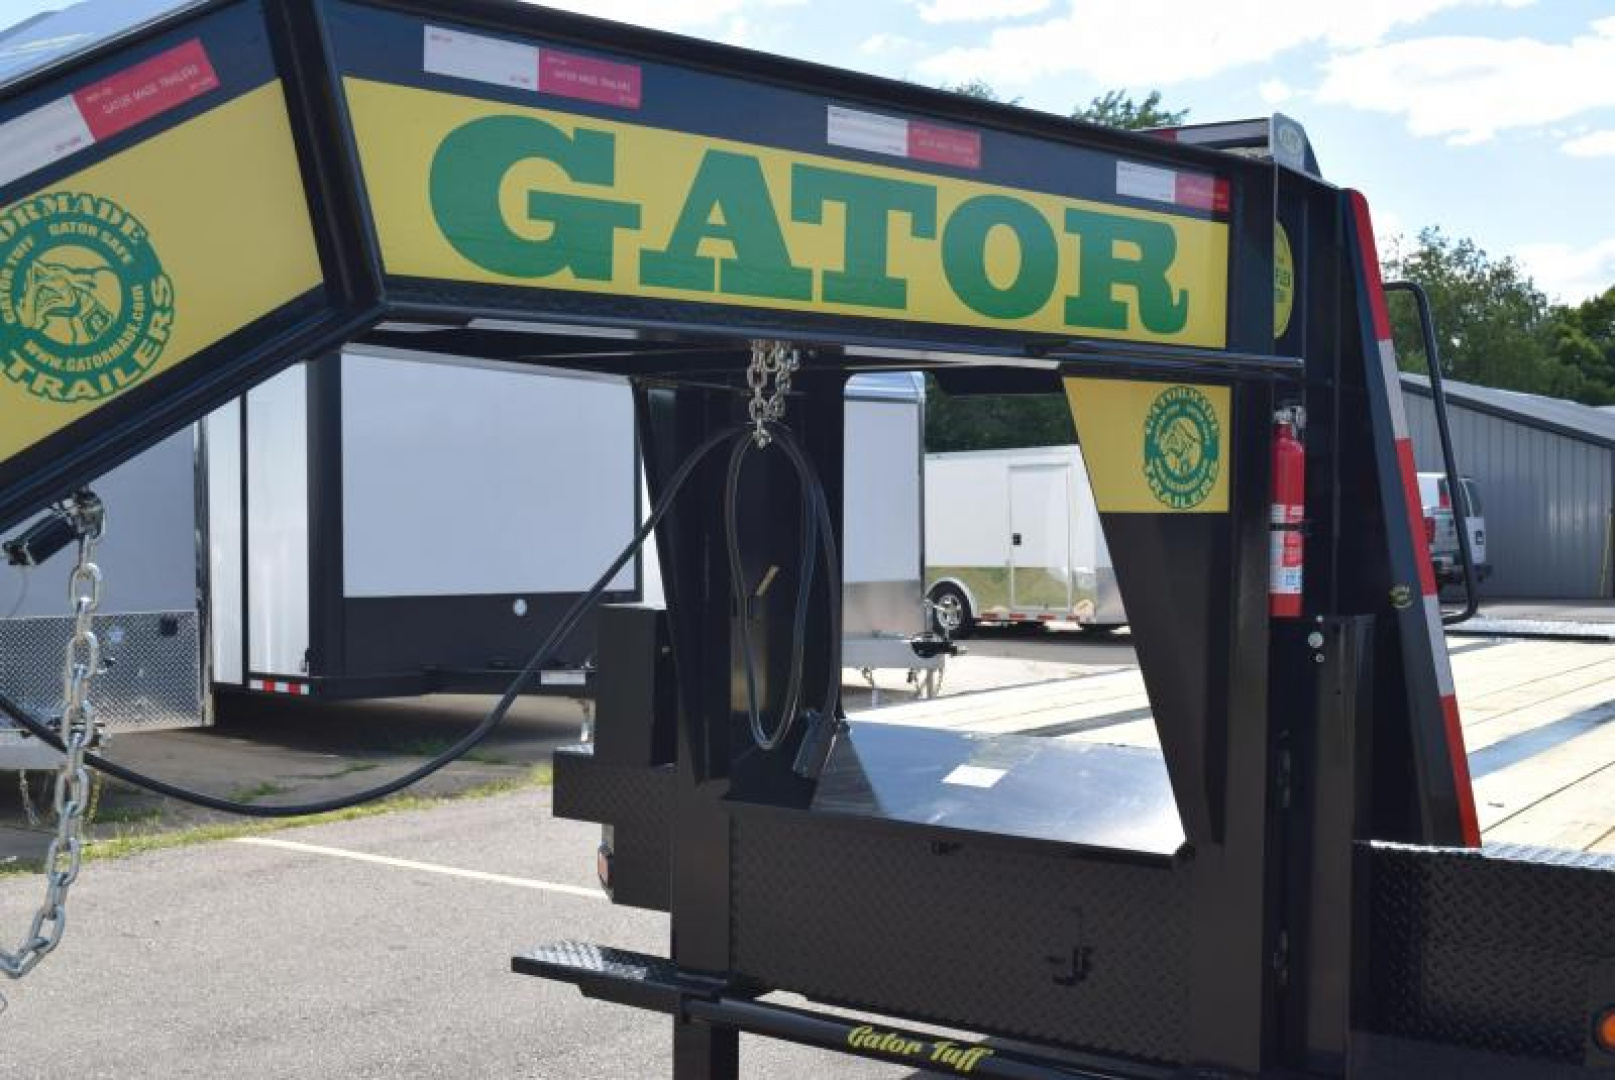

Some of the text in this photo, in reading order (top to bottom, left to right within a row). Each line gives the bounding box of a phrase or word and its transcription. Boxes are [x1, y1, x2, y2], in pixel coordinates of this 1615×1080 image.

[429, 114, 1188, 333] GATOR
[3, 271, 174, 402] TRAILERS
[847, 1024, 995, 1072] Gator Tuff
